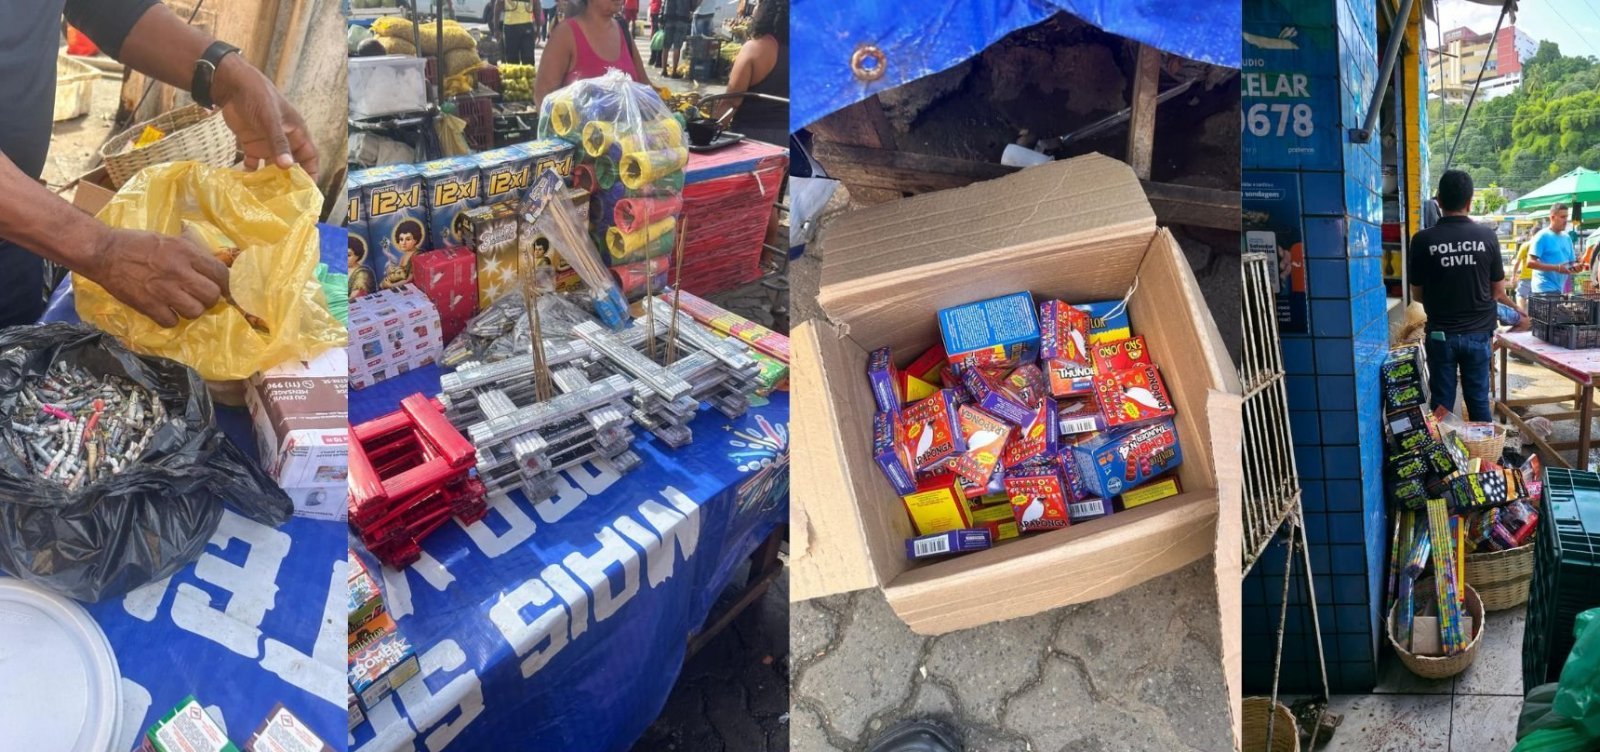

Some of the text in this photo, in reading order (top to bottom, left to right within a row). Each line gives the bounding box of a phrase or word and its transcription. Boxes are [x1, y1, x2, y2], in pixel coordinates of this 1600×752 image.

[1242, 103, 1314, 138] 678
[434, 176, 478, 206] 12x1
[488, 167, 529, 195] 12x1
[371, 184, 419, 217] 12x1
[1440, 254, 1477, 267] CIVIL
[1090, 317, 1106, 329] LOR
[1145, 367, 1171, 413] ARAPONGA
[1136, 425, 1167, 443] THUNDER
[913, 441, 954, 468] ARAPONGA
[1019, 516, 1068, 530] ARAPONGA
[488, 485, 701, 680] MAIS
[351, 640, 405, 682] BOMBA
